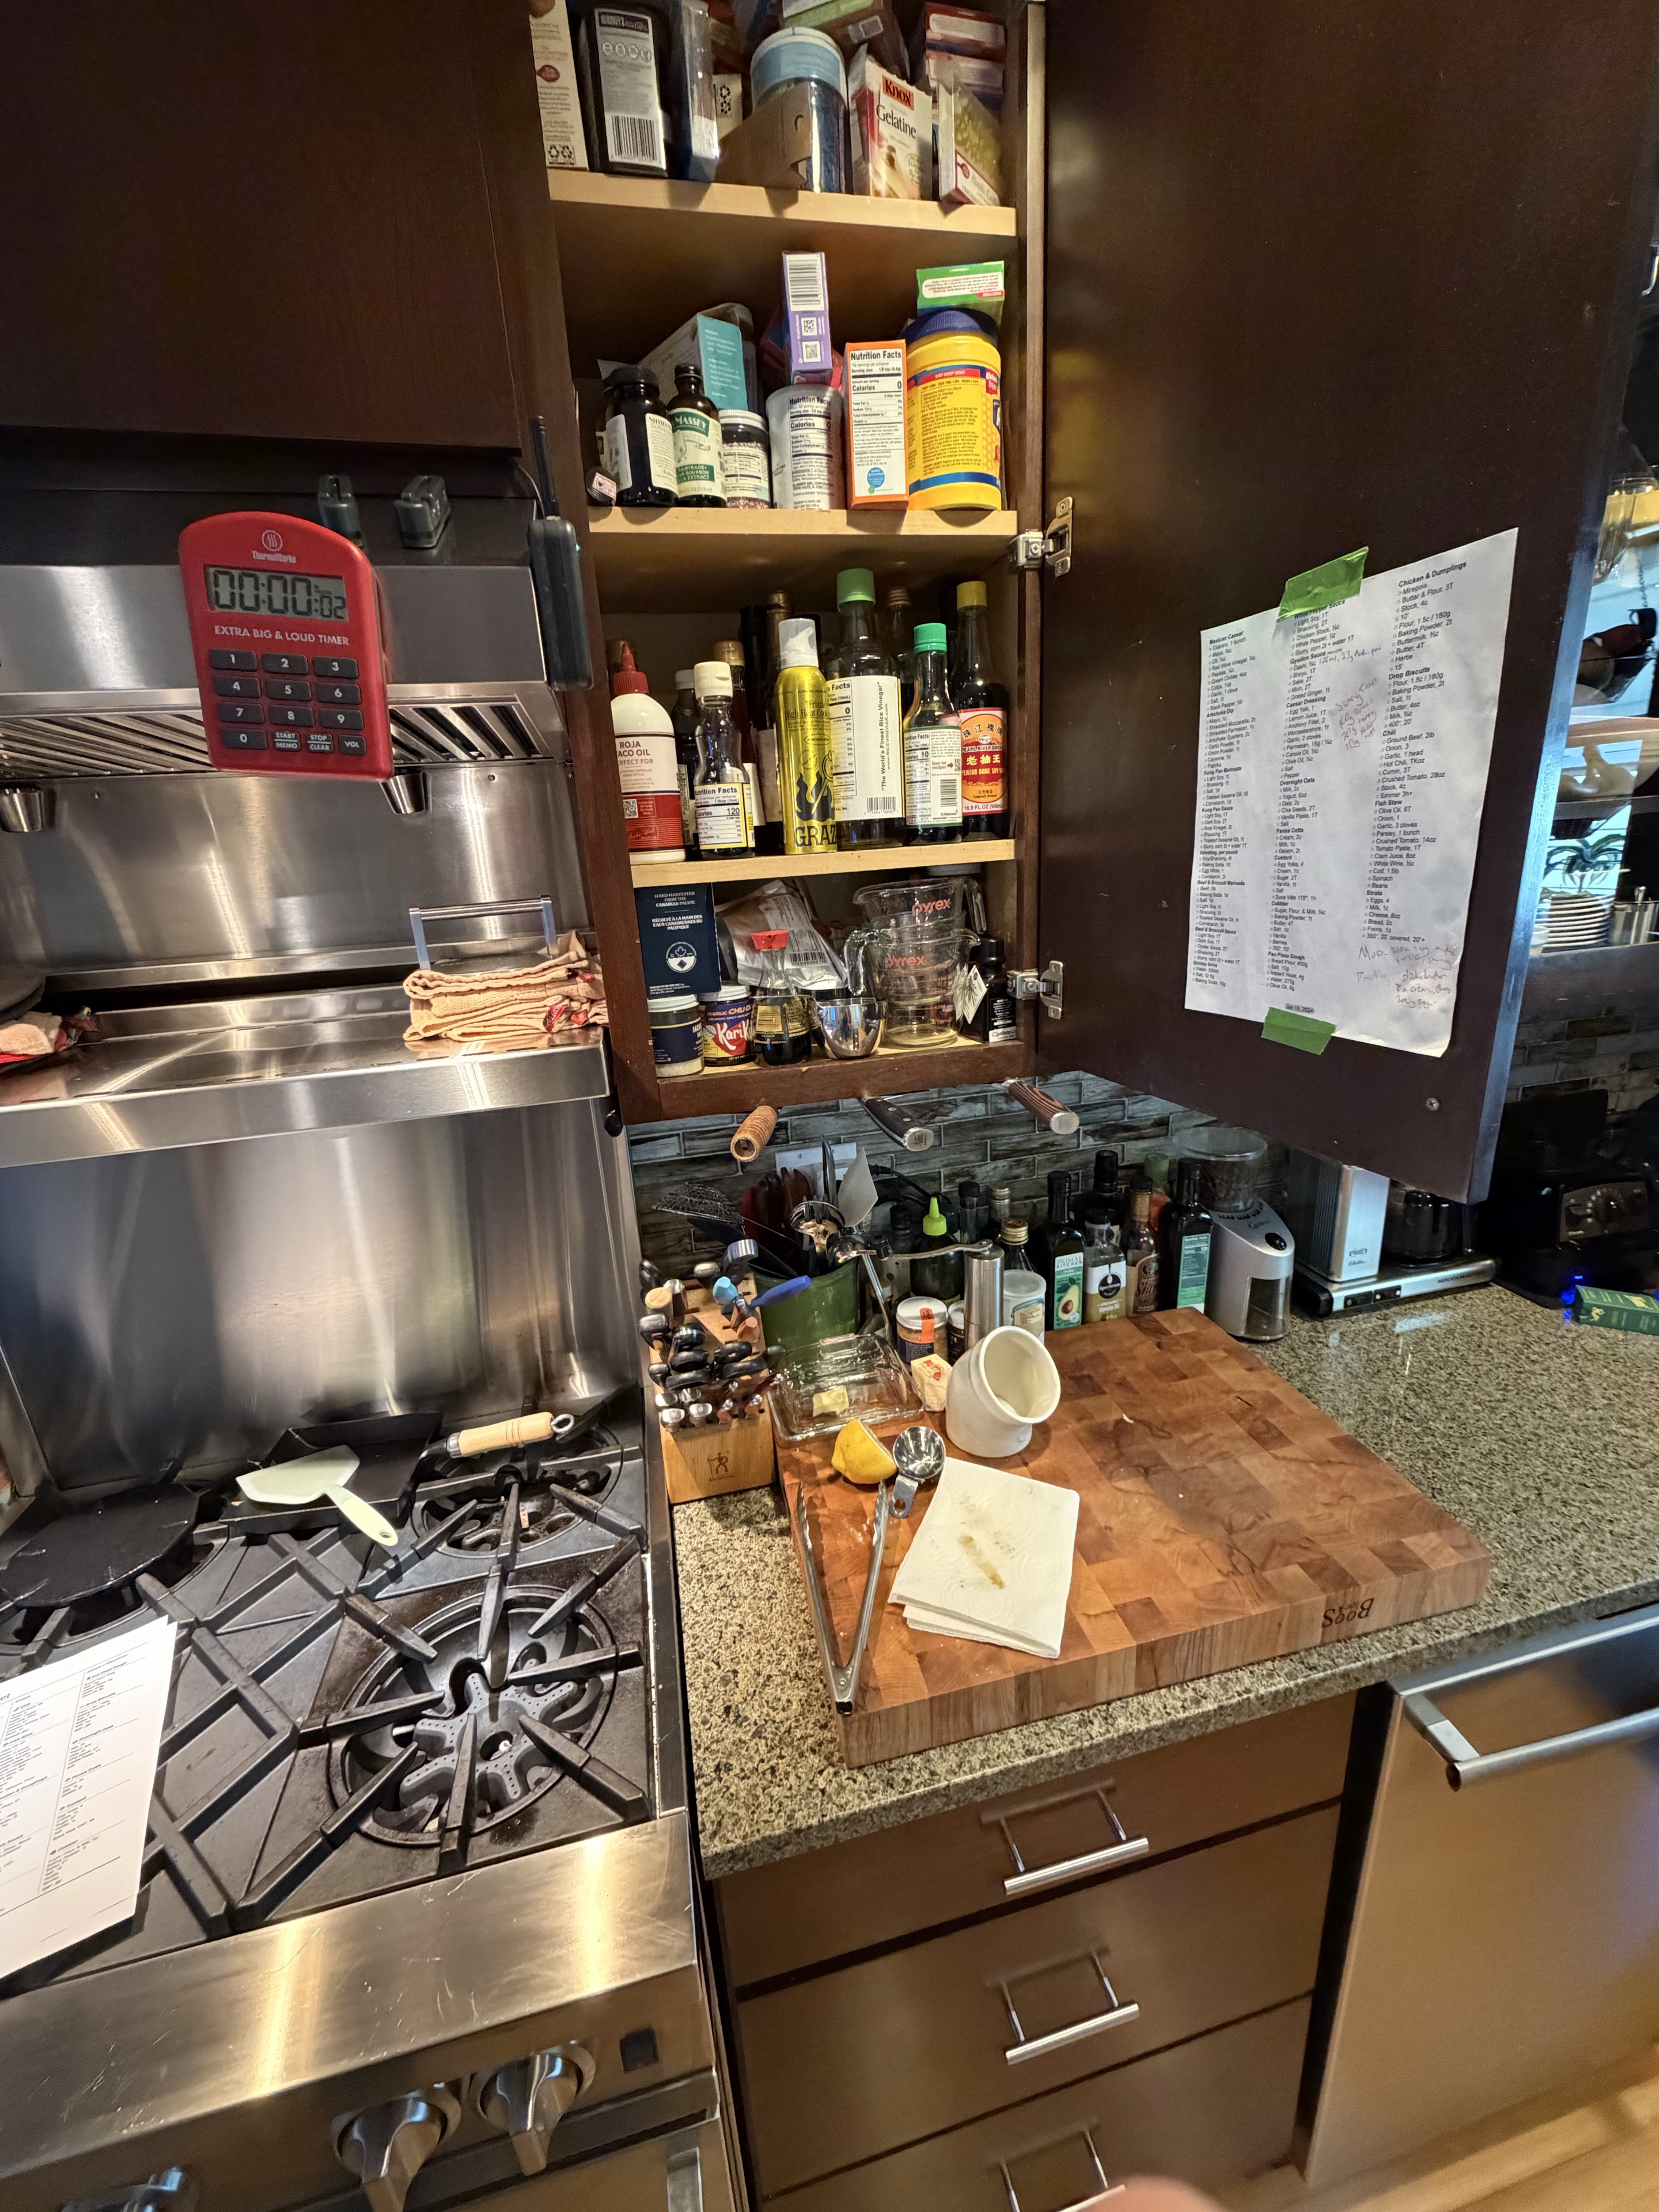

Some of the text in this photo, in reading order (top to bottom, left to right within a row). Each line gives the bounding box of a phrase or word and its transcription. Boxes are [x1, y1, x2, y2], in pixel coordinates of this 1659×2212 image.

[876, 104, 916, 139] Gelatine
[851, 350, 901, 361] Nutrition Facts
[897, 381, 902, 389] 0
[790, 396, 815, 405] Nutrition
[675, 415, 707, 429] MASSEY
[827, 421, 831, 429] 0
[1399, 575, 1424, 588] Chicken
[1431, 562, 1467, 578] Dumplings
[1402, 595, 1421, 604] Butter
[1445, 582, 1454, 590] 3T
[1403, 583, 1427, 595] Mirepoix
[214, 624, 349, 646] EXTRA BIG & LOUD TIMER
[1397, 627, 1418, 637] Baking
[1210, 631, 1244, 645] Mexican Caesar
[230, 654, 236, 664] 1
[1290, 652, 1325, 664] Gyudon Sauce
[1395, 654, 1413, 662] Herbs
[281, 658, 290, 669] 2
[331, 662, 339, 672] 3
[1388, 666, 1430, 680] Drop Biscuits
[233, 680, 241, 691] 4
[285, 685, 292, 695] 5
[832, 682, 851, 690] Facts
[334, 688, 343, 698] 6
[1286, 696, 1325, 709] Caesar Dressing
[236, 707, 244, 718] 7
[287, 710, 295, 721] 8
[785, 709, 800, 719] High
[337, 714, 345, 724] 9
[240, 733, 248, 743] 0
[275, 731, 296, 740] START
[1387, 736, 1407, 744] Ground
[275, 741, 298, 749] MEMO
[309, 743, 330, 751] CLEAR
[344, 740, 360, 748] VOL
[620, 741, 641, 749] ROJA
[966, 755, 1000, 766] 老抽王
[911, 898, 951, 916] pyrex
[884, 955, 926, 969] pyrex
[1057, 1255, 1081, 1264] PRIMAL
[924, 1359, 941, 1381] BUTTE
